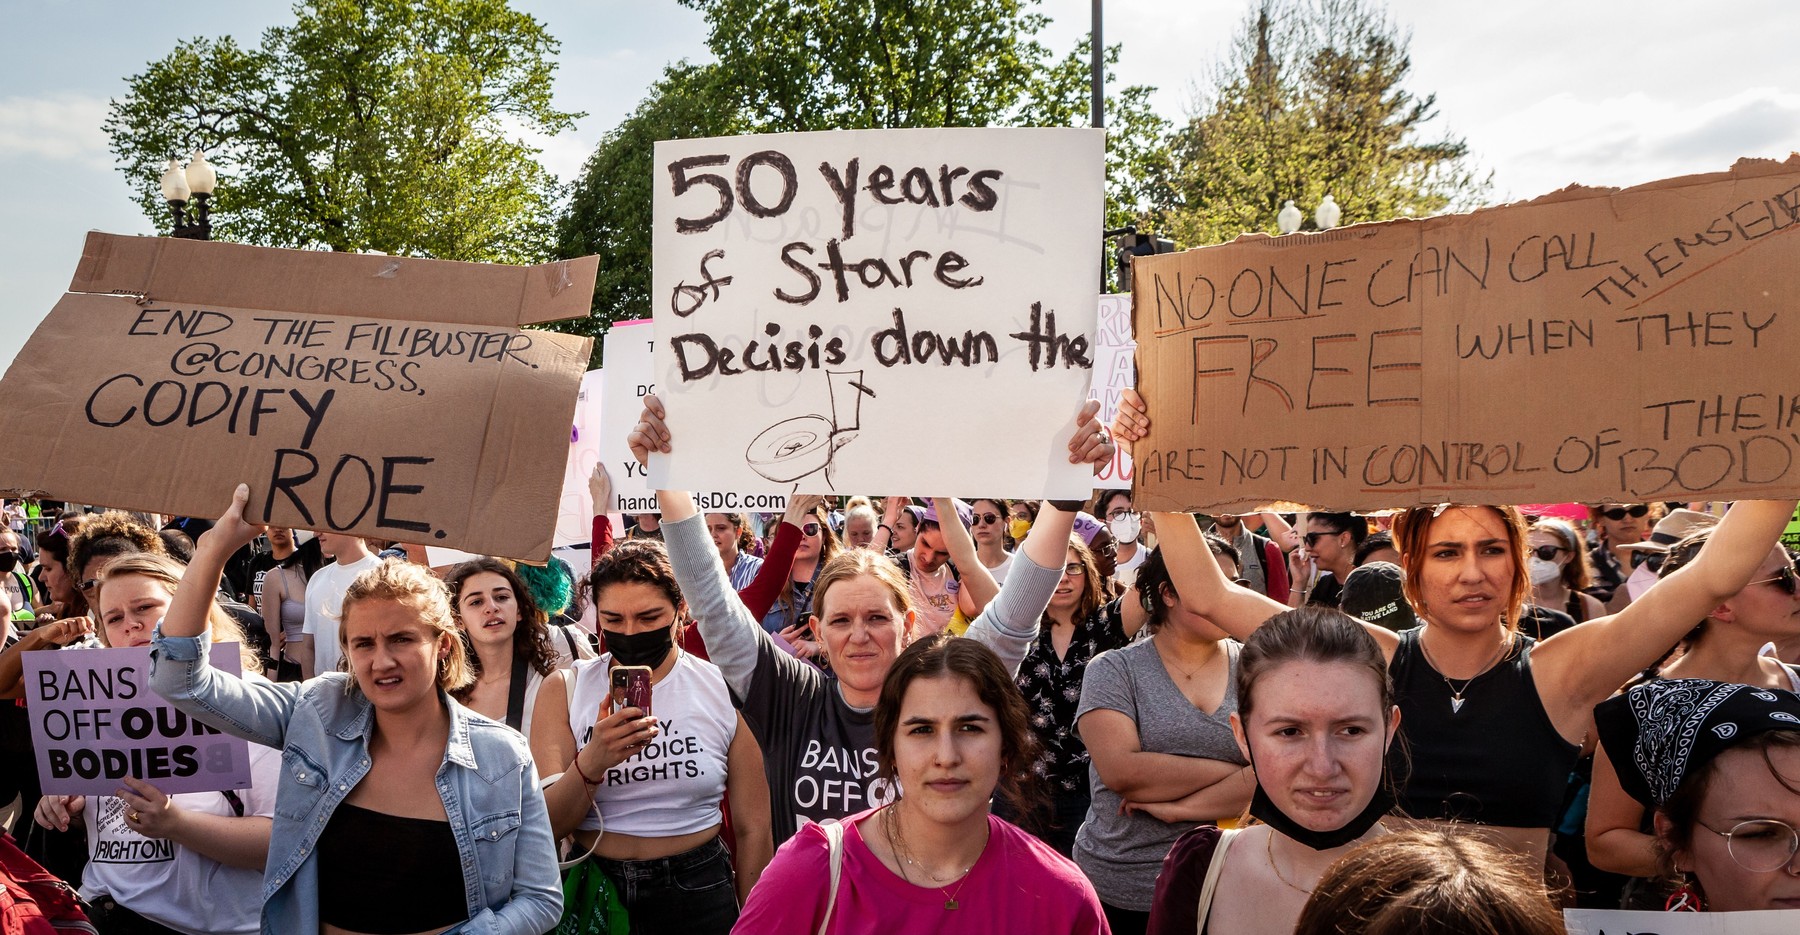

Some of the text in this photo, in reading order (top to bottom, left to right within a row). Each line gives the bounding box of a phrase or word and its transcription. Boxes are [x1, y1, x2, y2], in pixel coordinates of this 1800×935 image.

[667, 150, 1004, 242] 50 years
[671, 238, 984, 318] of Stare
[1368, 237, 1490, 307] CAN
[1508, 232, 1619, 283] CALL
[128, 308, 539, 370] END THE FILIBUSTER.
[670, 322, 848, 383] Decisis
[871, 307, 999, 369] down
[1009, 300, 1094, 372] the
[171, 342, 426, 397] @CONGRESS,
[1191, 311, 1779, 425] FREE WHEN THEY
[85, 373, 336, 450] CODIFY
[1141, 448, 1206, 487] ARE
[1220, 445, 1300, 485] NOT
[1313, 446, 1348, 484] IN
[1362, 441, 1543, 487] CONTROL
[1553, 427, 1622, 474] OF
[1618, 433, 1800, 497] BOD
[263, 448, 448, 540] ROE.
[1374, 605, 1387, 615] ARE
[1387, 601, 1396, 609] ON
[1382, 606, 1398, 617] LAND
[38, 667, 137, 701] BANS
[43, 709, 112, 741] OFF
[626, 736, 704, 763] HOICE.
[48, 745, 199, 780] BODIES
[607, 760, 705, 787] RIGHTS.
[800, 740, 880, 780] BANS
[794, 775, 862, 812] OFF
